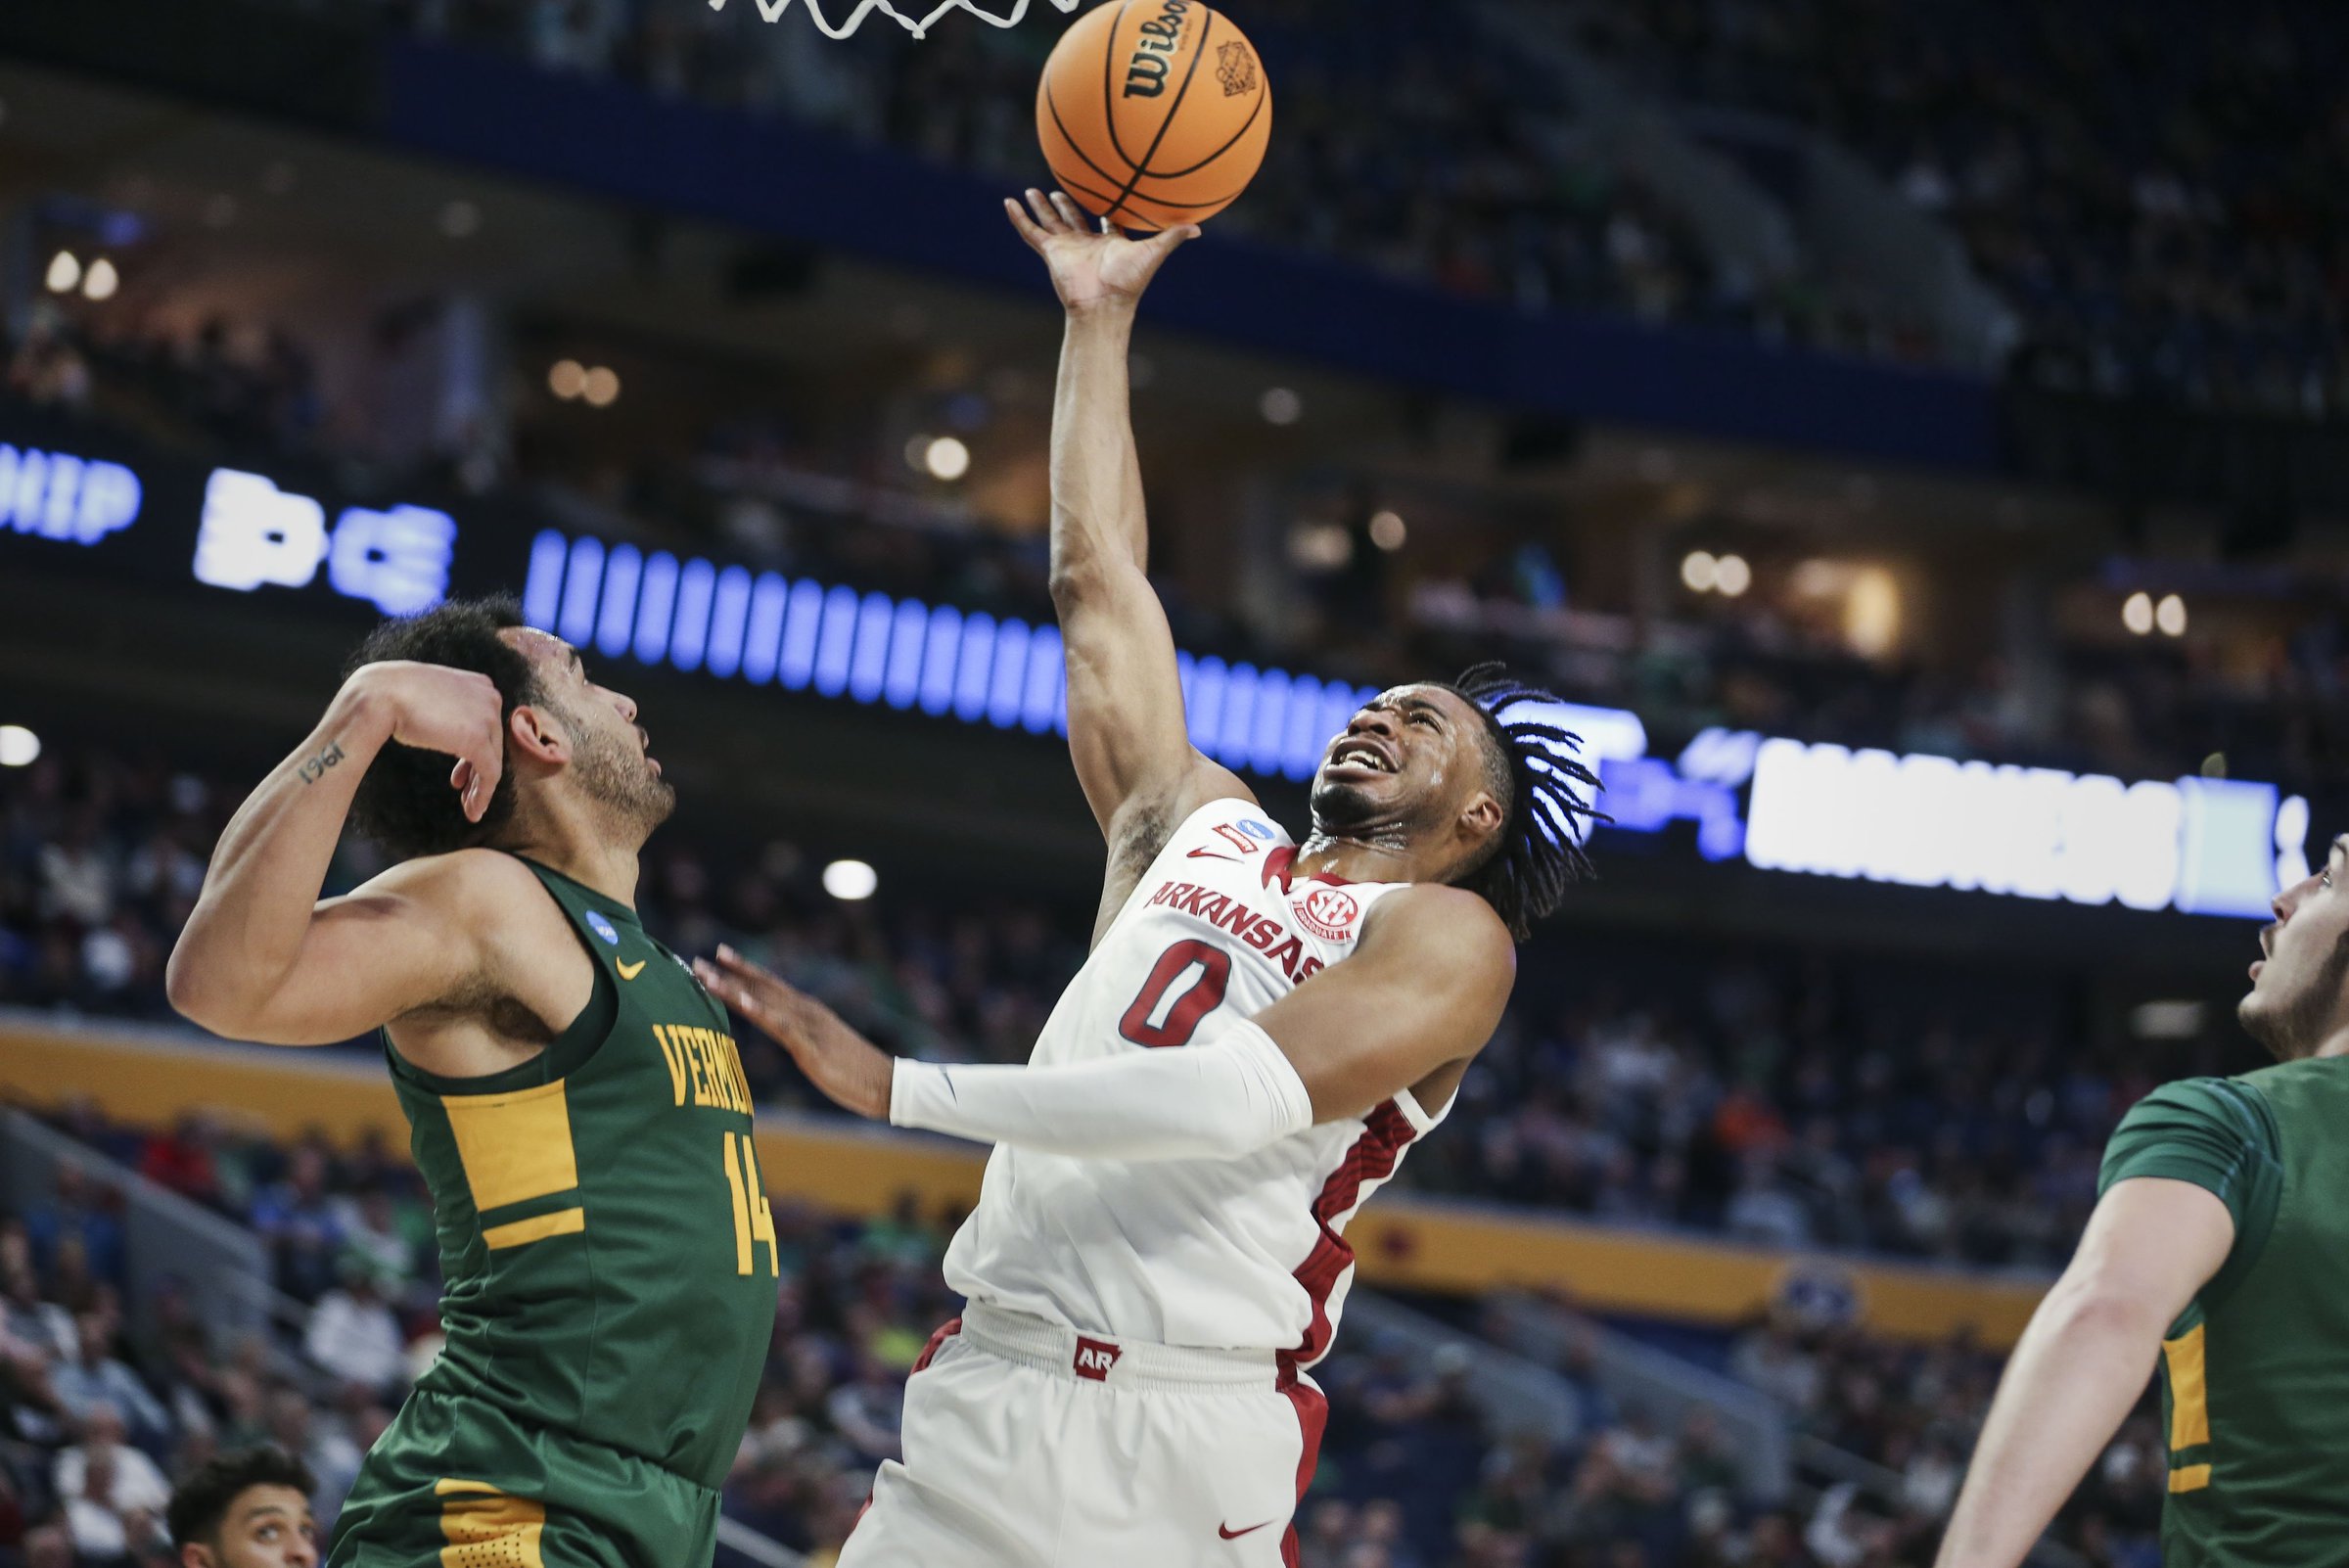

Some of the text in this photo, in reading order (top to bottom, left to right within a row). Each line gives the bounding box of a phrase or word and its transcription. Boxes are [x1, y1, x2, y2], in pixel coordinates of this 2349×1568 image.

[298, 741, 345, 784] 1961
[1310, 891, 1355, 927] SEC
[1119, 939, 1231, 1047] 0
[725, 1131, 779, 1277] 14
[1078, 1347, 1114, 1371] AR
